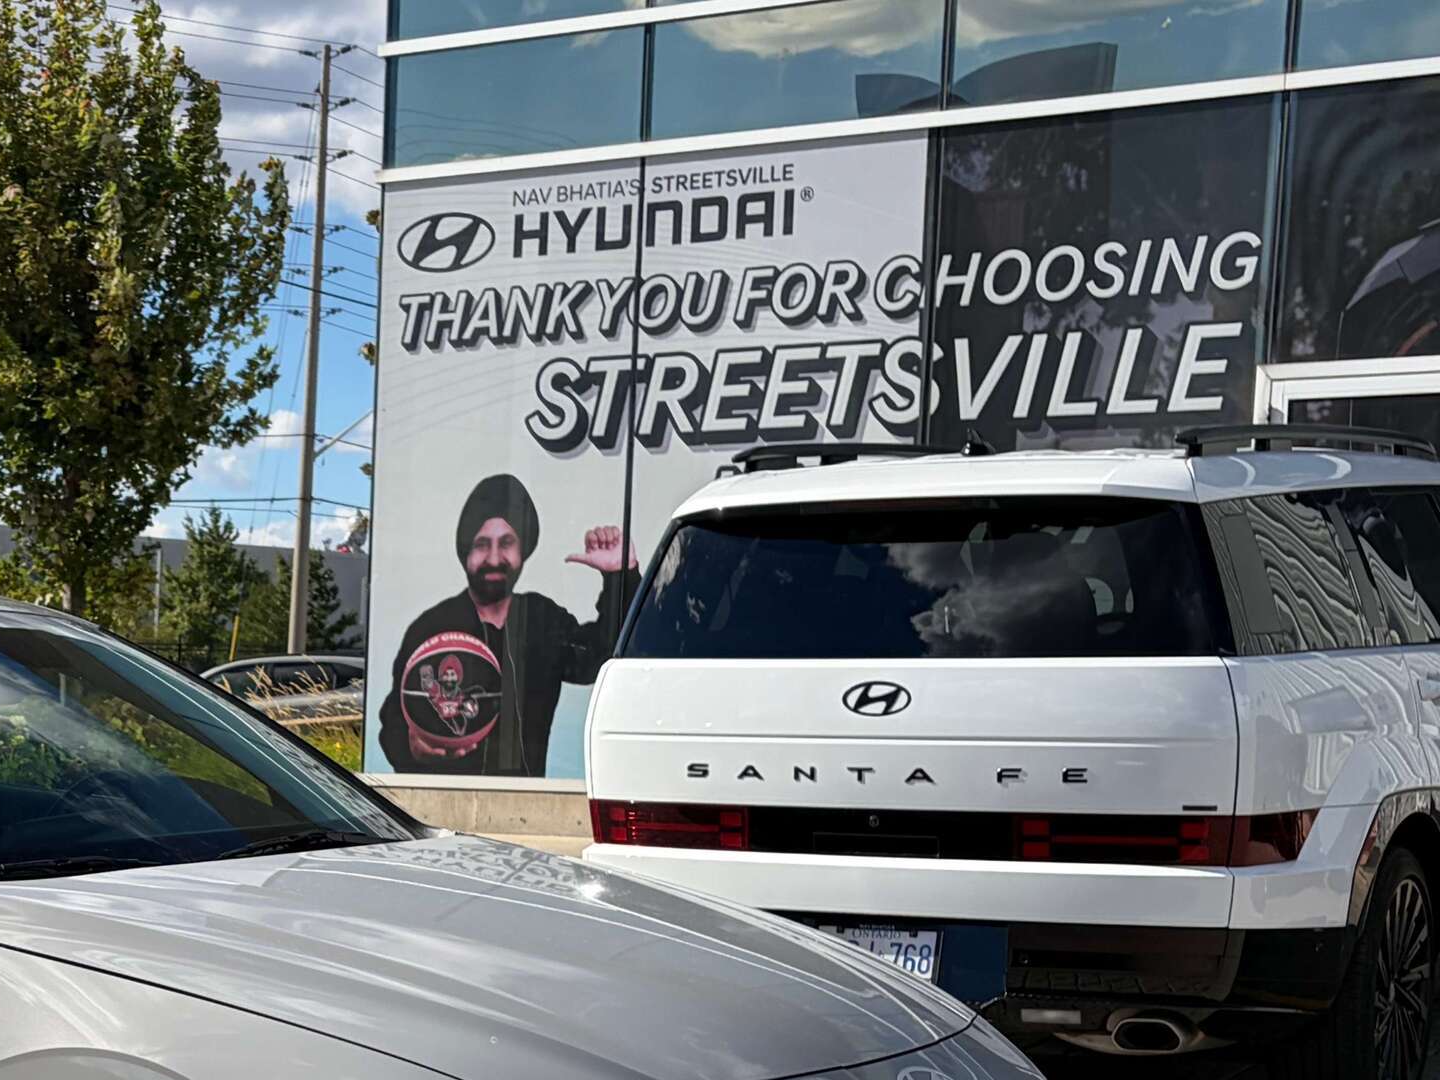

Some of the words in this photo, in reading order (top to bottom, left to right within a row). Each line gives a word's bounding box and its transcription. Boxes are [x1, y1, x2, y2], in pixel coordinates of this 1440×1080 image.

[512, 187, 552, 206] NAV
[556, 179, 641, 203] BHATIA'S
[651, 163, 795, 194] STREETSVILLE
[399, 281, 593, 352] THANK
[595, 267, 730, 342] YOU
[733, 258, 868, 332] FOR
[874, 230, 1263, 320] CHOOSING
[526, 320, 1244, 453] STREETSVILLE
[686, 762, 935, 785] SANTA
[996, 767, 1088, 784] FE
[852, 927, 902, 939] ONTARIO
